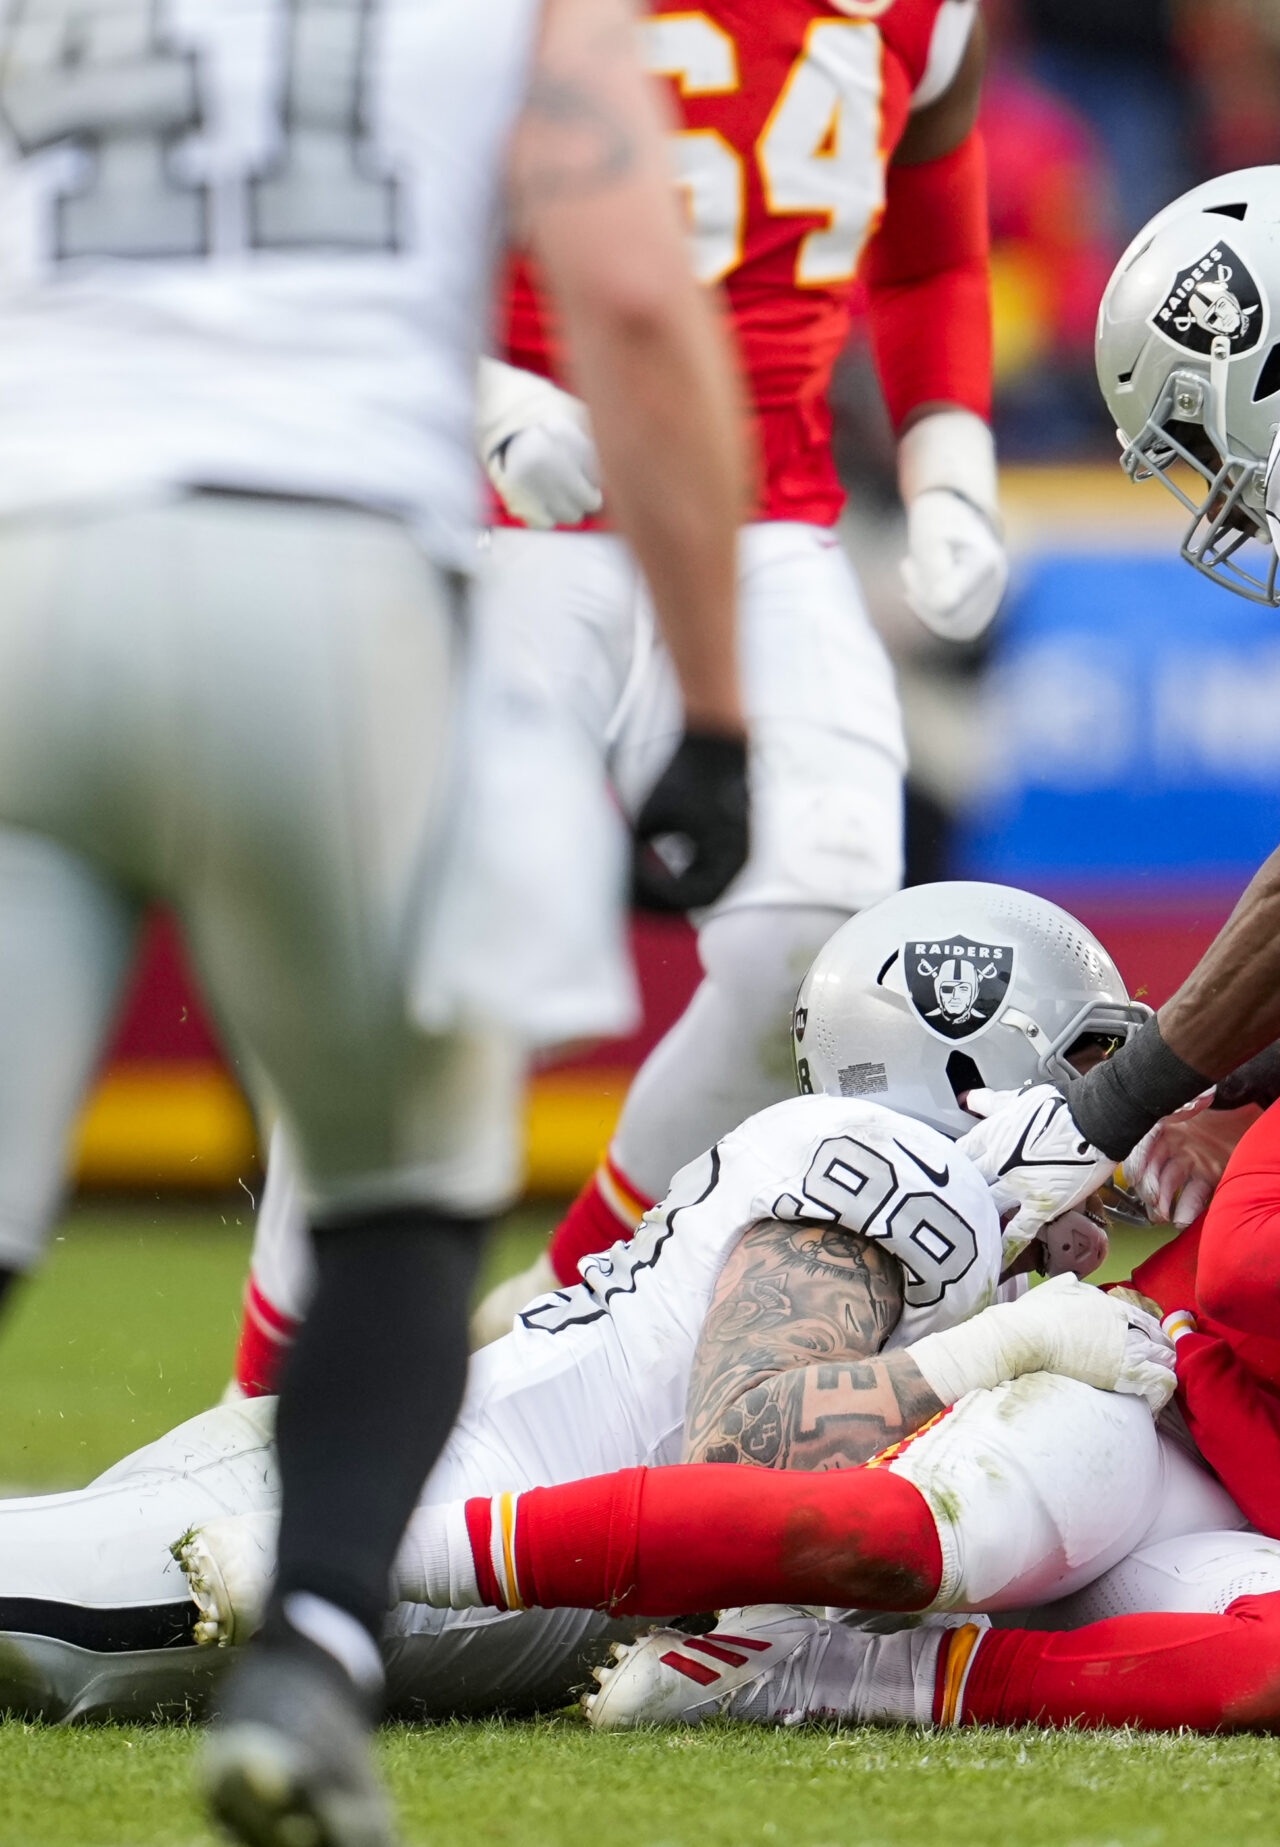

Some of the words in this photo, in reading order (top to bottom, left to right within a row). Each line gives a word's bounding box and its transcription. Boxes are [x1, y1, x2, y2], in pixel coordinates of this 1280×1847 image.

[0, 0, 404, 261] 41
[637, 10, 887, 290] 64
[1158, 248, 1223, 322] RAIDERS
[914, 942, 1004, 960] RAIDERS
